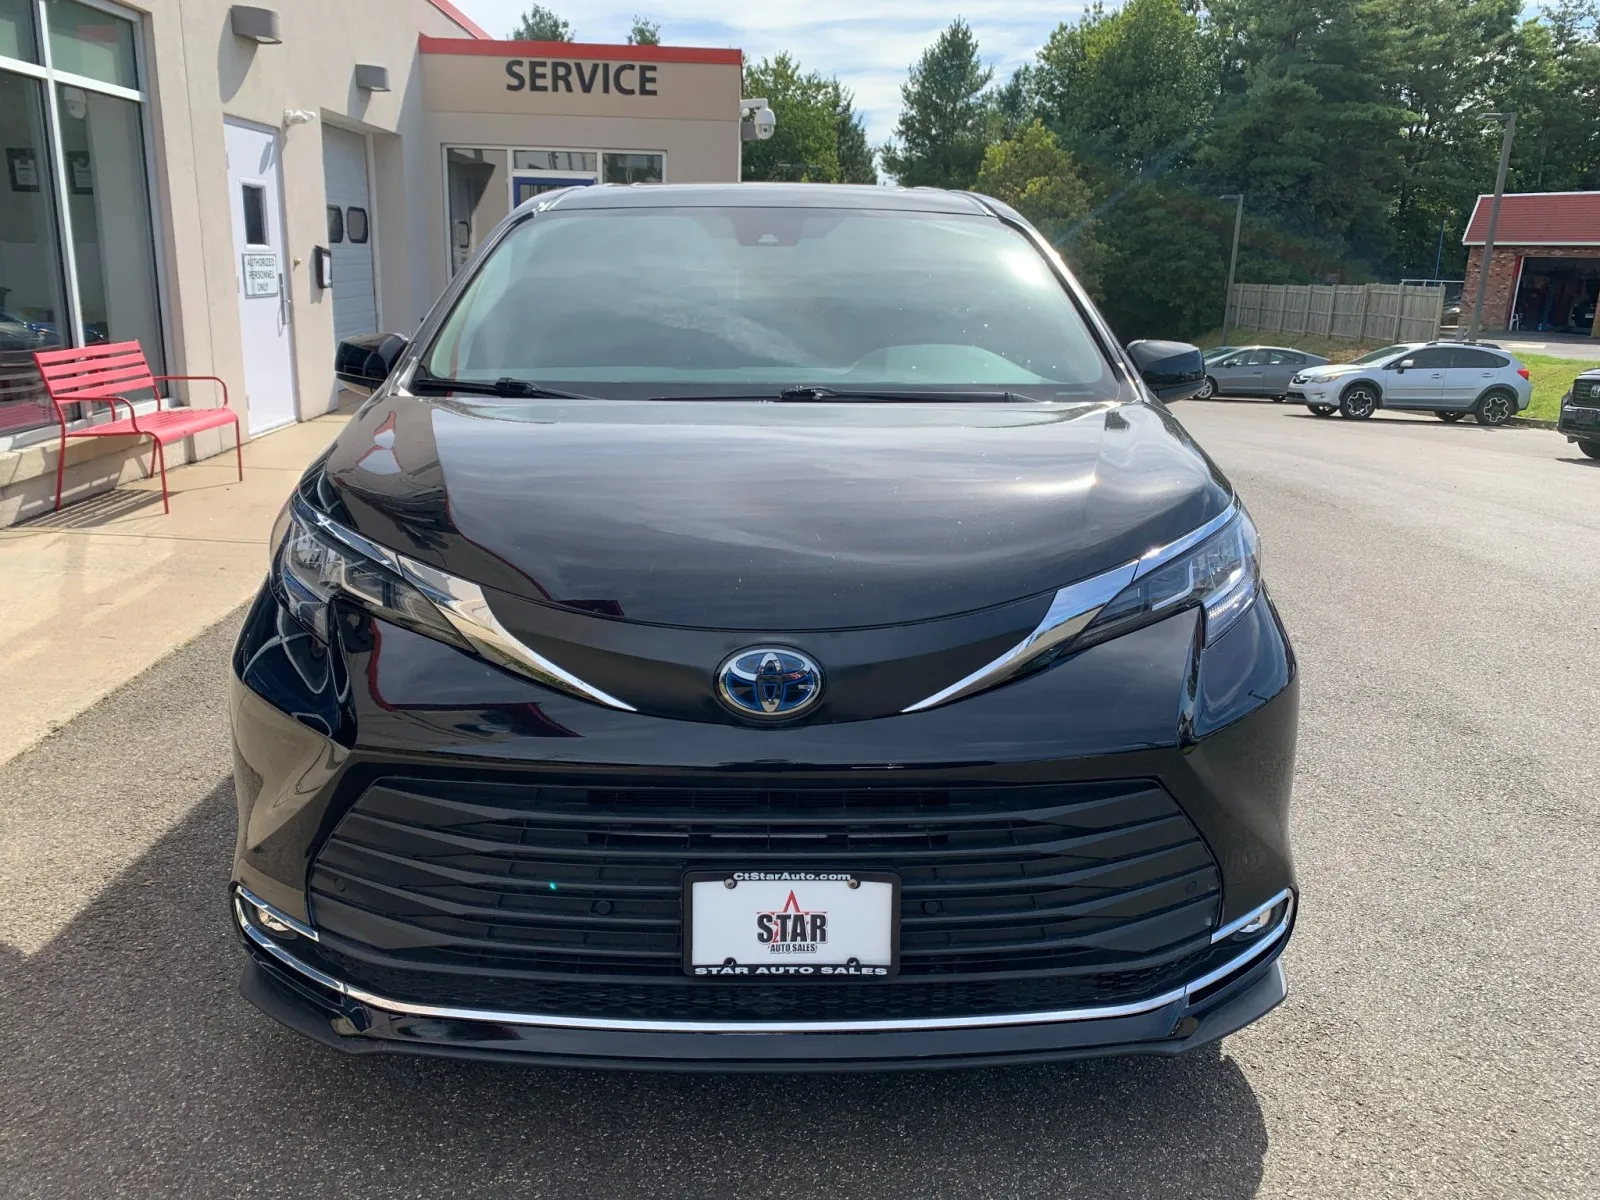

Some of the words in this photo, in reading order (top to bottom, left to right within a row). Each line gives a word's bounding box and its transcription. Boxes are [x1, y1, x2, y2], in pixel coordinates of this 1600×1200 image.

[505, 59, 658, 96] SERVICE
[247, 258, 274, 267] AUTHORIZED
[248, 270, 275, 280] PERSONNEL
[257, 283, 268, 291] ONLY
[733, 872, 851, 881] CtStarAuto.com
[756, 913, 827, 943] STAR
[769, 944, 791, 952] AUTO
[792, 944, 816, 952] SALES
[695, 966, 750, 975] STAR
[754, 966, 814, 975] AUTO
[820, 966, 888, 976] SALES
